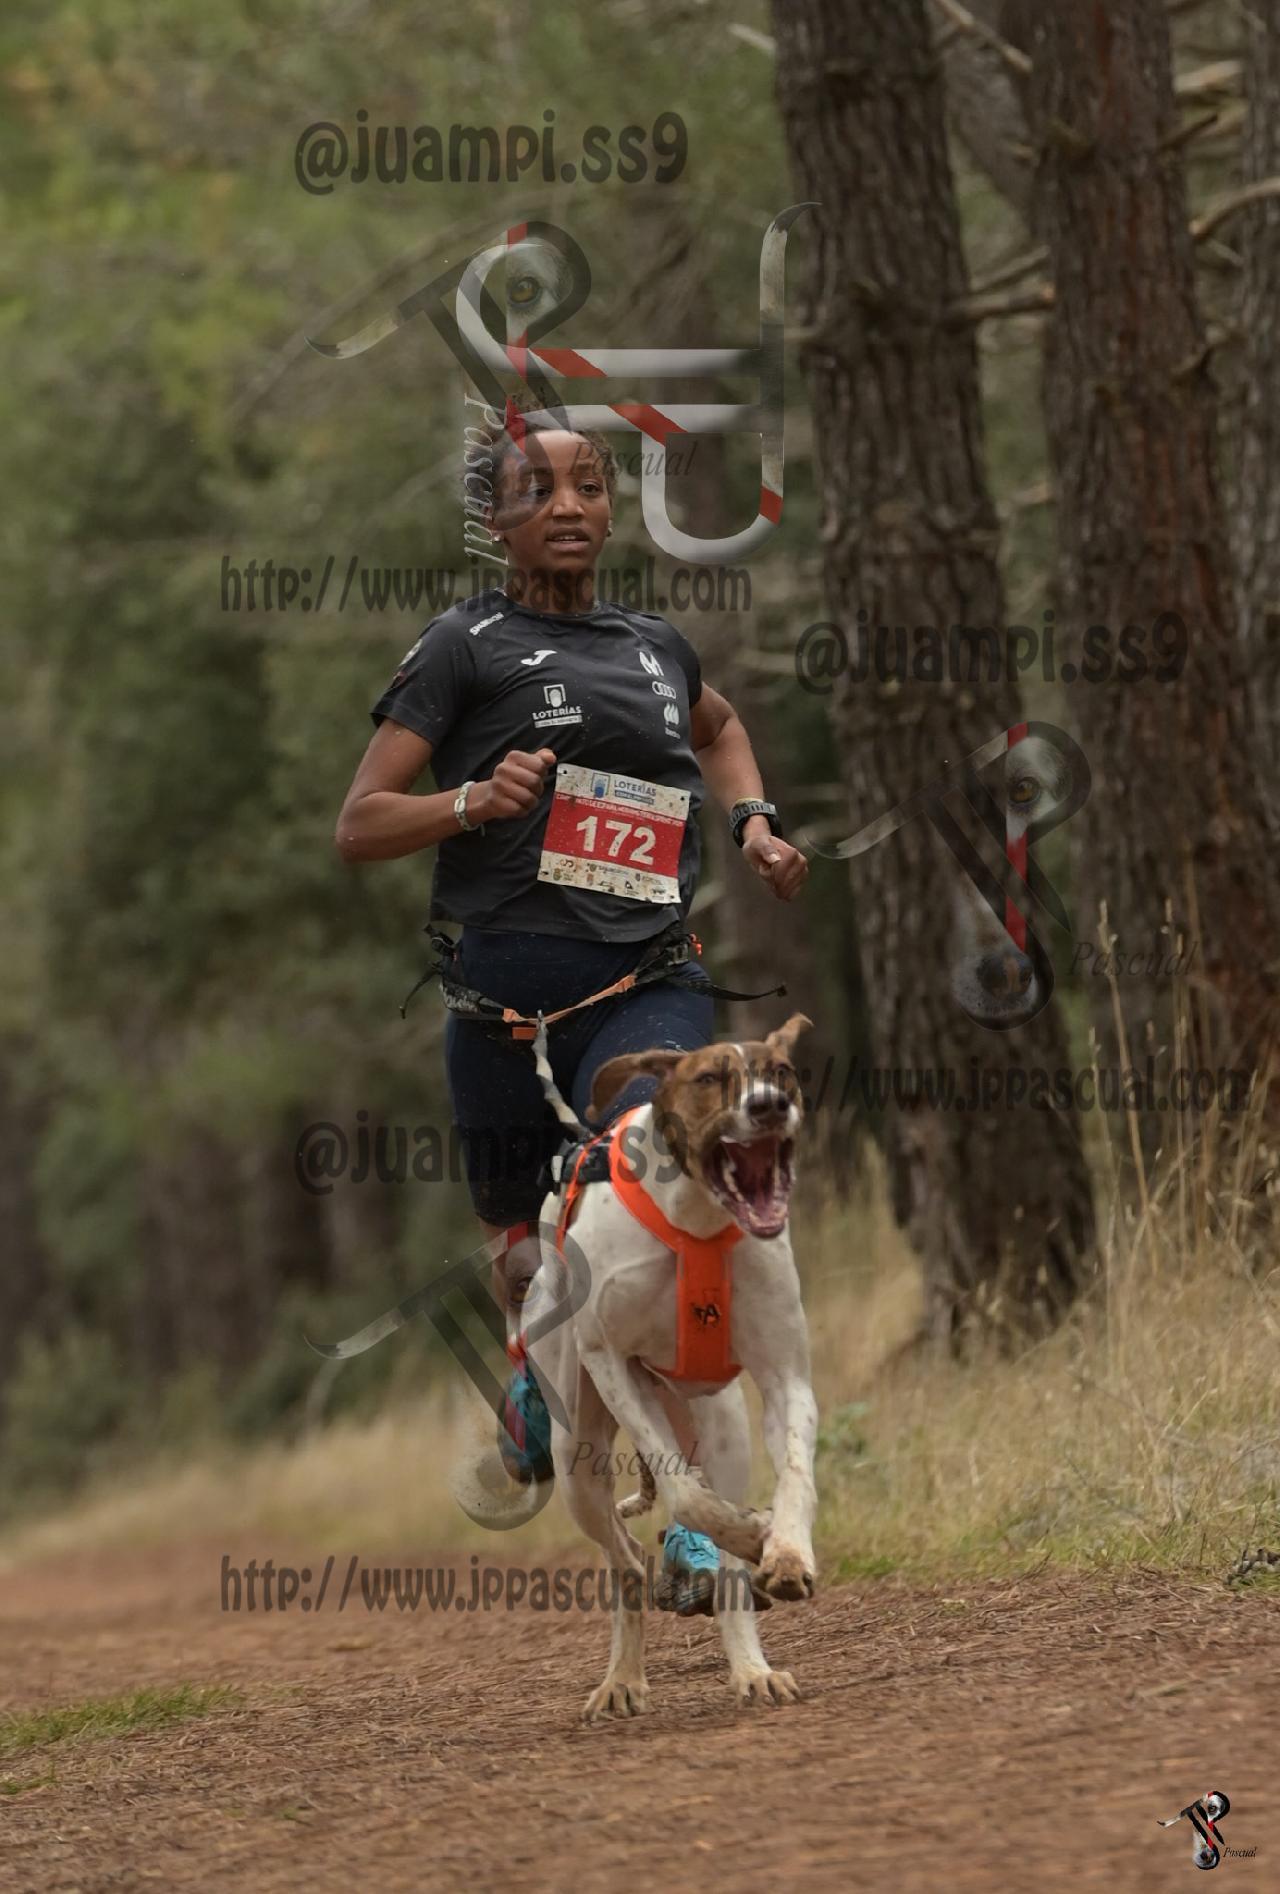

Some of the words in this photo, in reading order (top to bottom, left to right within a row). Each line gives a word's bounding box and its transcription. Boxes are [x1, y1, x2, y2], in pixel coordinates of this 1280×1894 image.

[532, 705, 582, 720] LOTERÍAS
[614, 780, 657, 797] LOTERÍAS
[575, 815, 657, 866] 172
